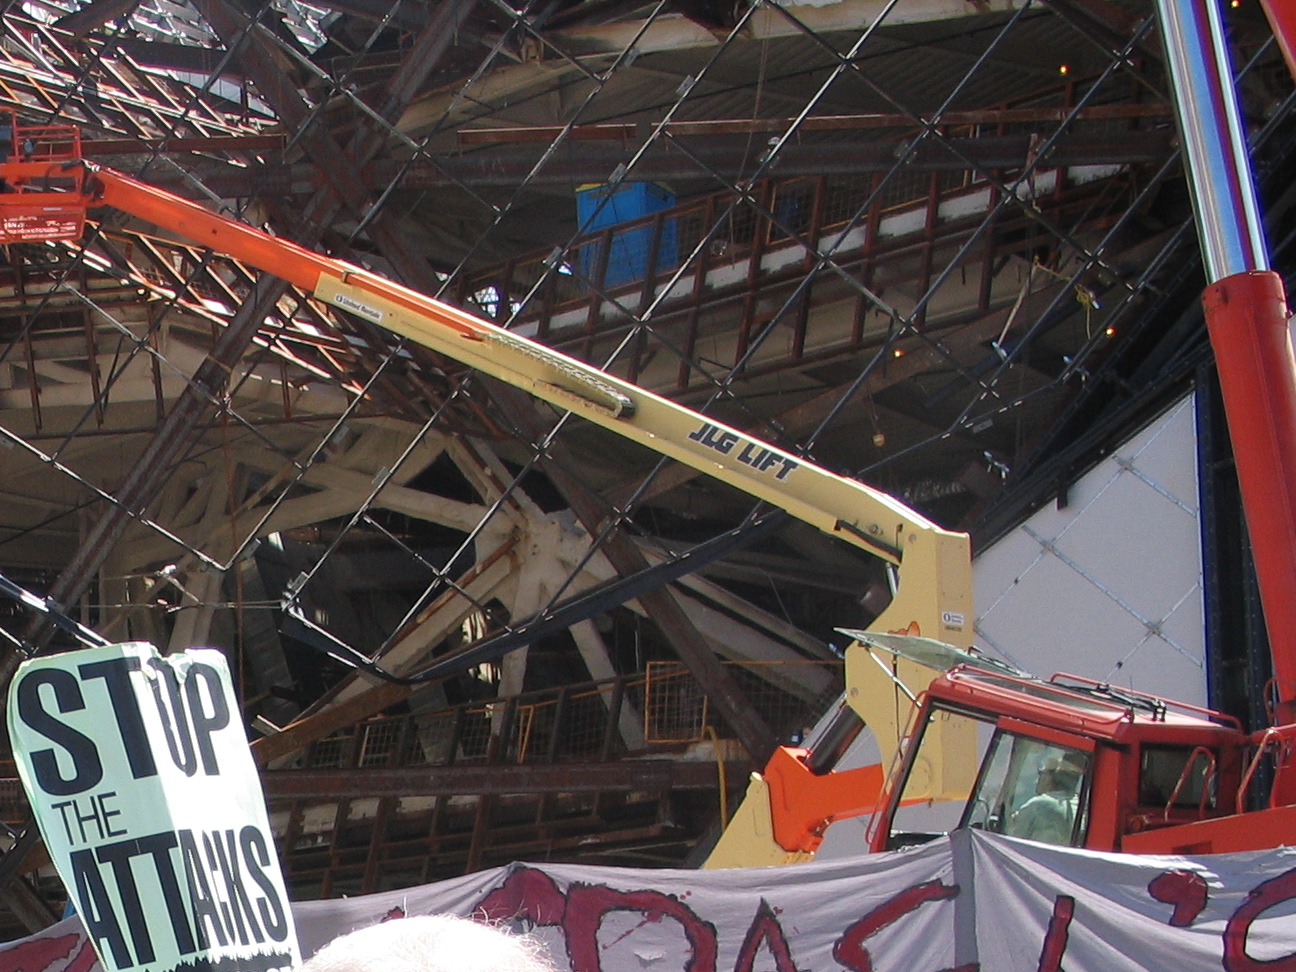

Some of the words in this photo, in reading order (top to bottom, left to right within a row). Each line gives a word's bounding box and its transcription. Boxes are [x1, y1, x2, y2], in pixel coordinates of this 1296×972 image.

[688, 423, 740, 454] JLG
[736, 442, 798, 480] LIFT
[17, 656, 231, 796] STOP
[51, 790, 128, 846] THE
[70, 825, 289, 970] ATTACKS
